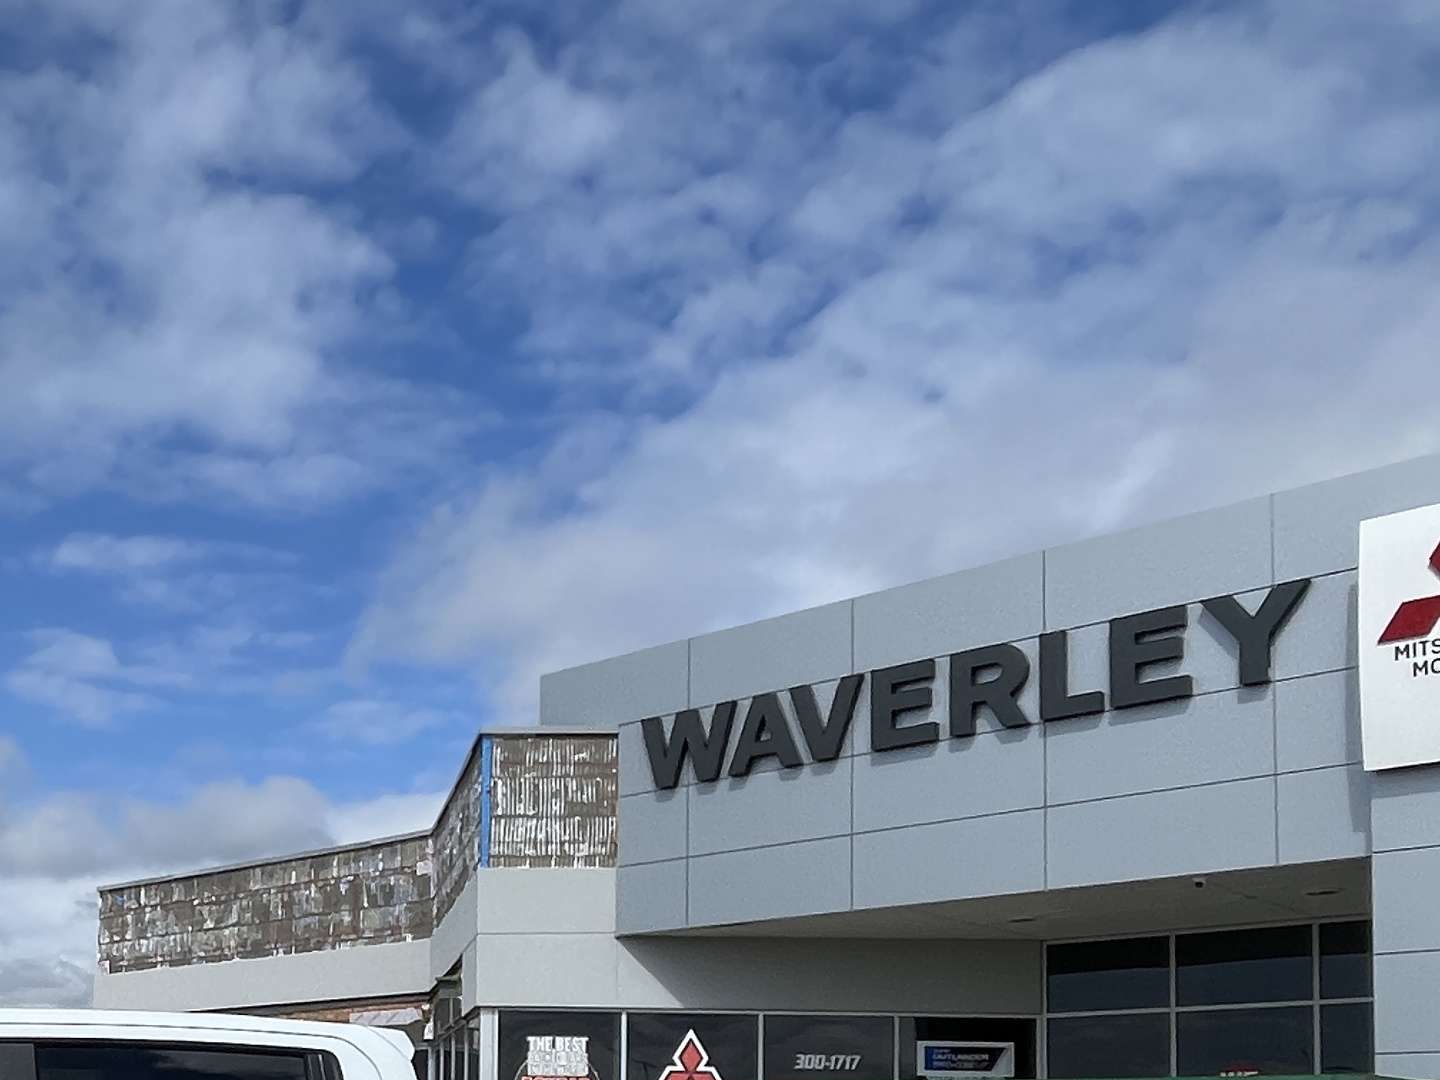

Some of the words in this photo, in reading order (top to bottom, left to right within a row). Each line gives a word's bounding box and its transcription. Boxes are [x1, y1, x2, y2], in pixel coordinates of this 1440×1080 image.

[641, 579, 1312, 790] WAVERLEY
[526, 1036, 553, 1052] THE
[555, 1036, 589, 1052] BEST
[793, 1054, 861, 1070] 300-1717
